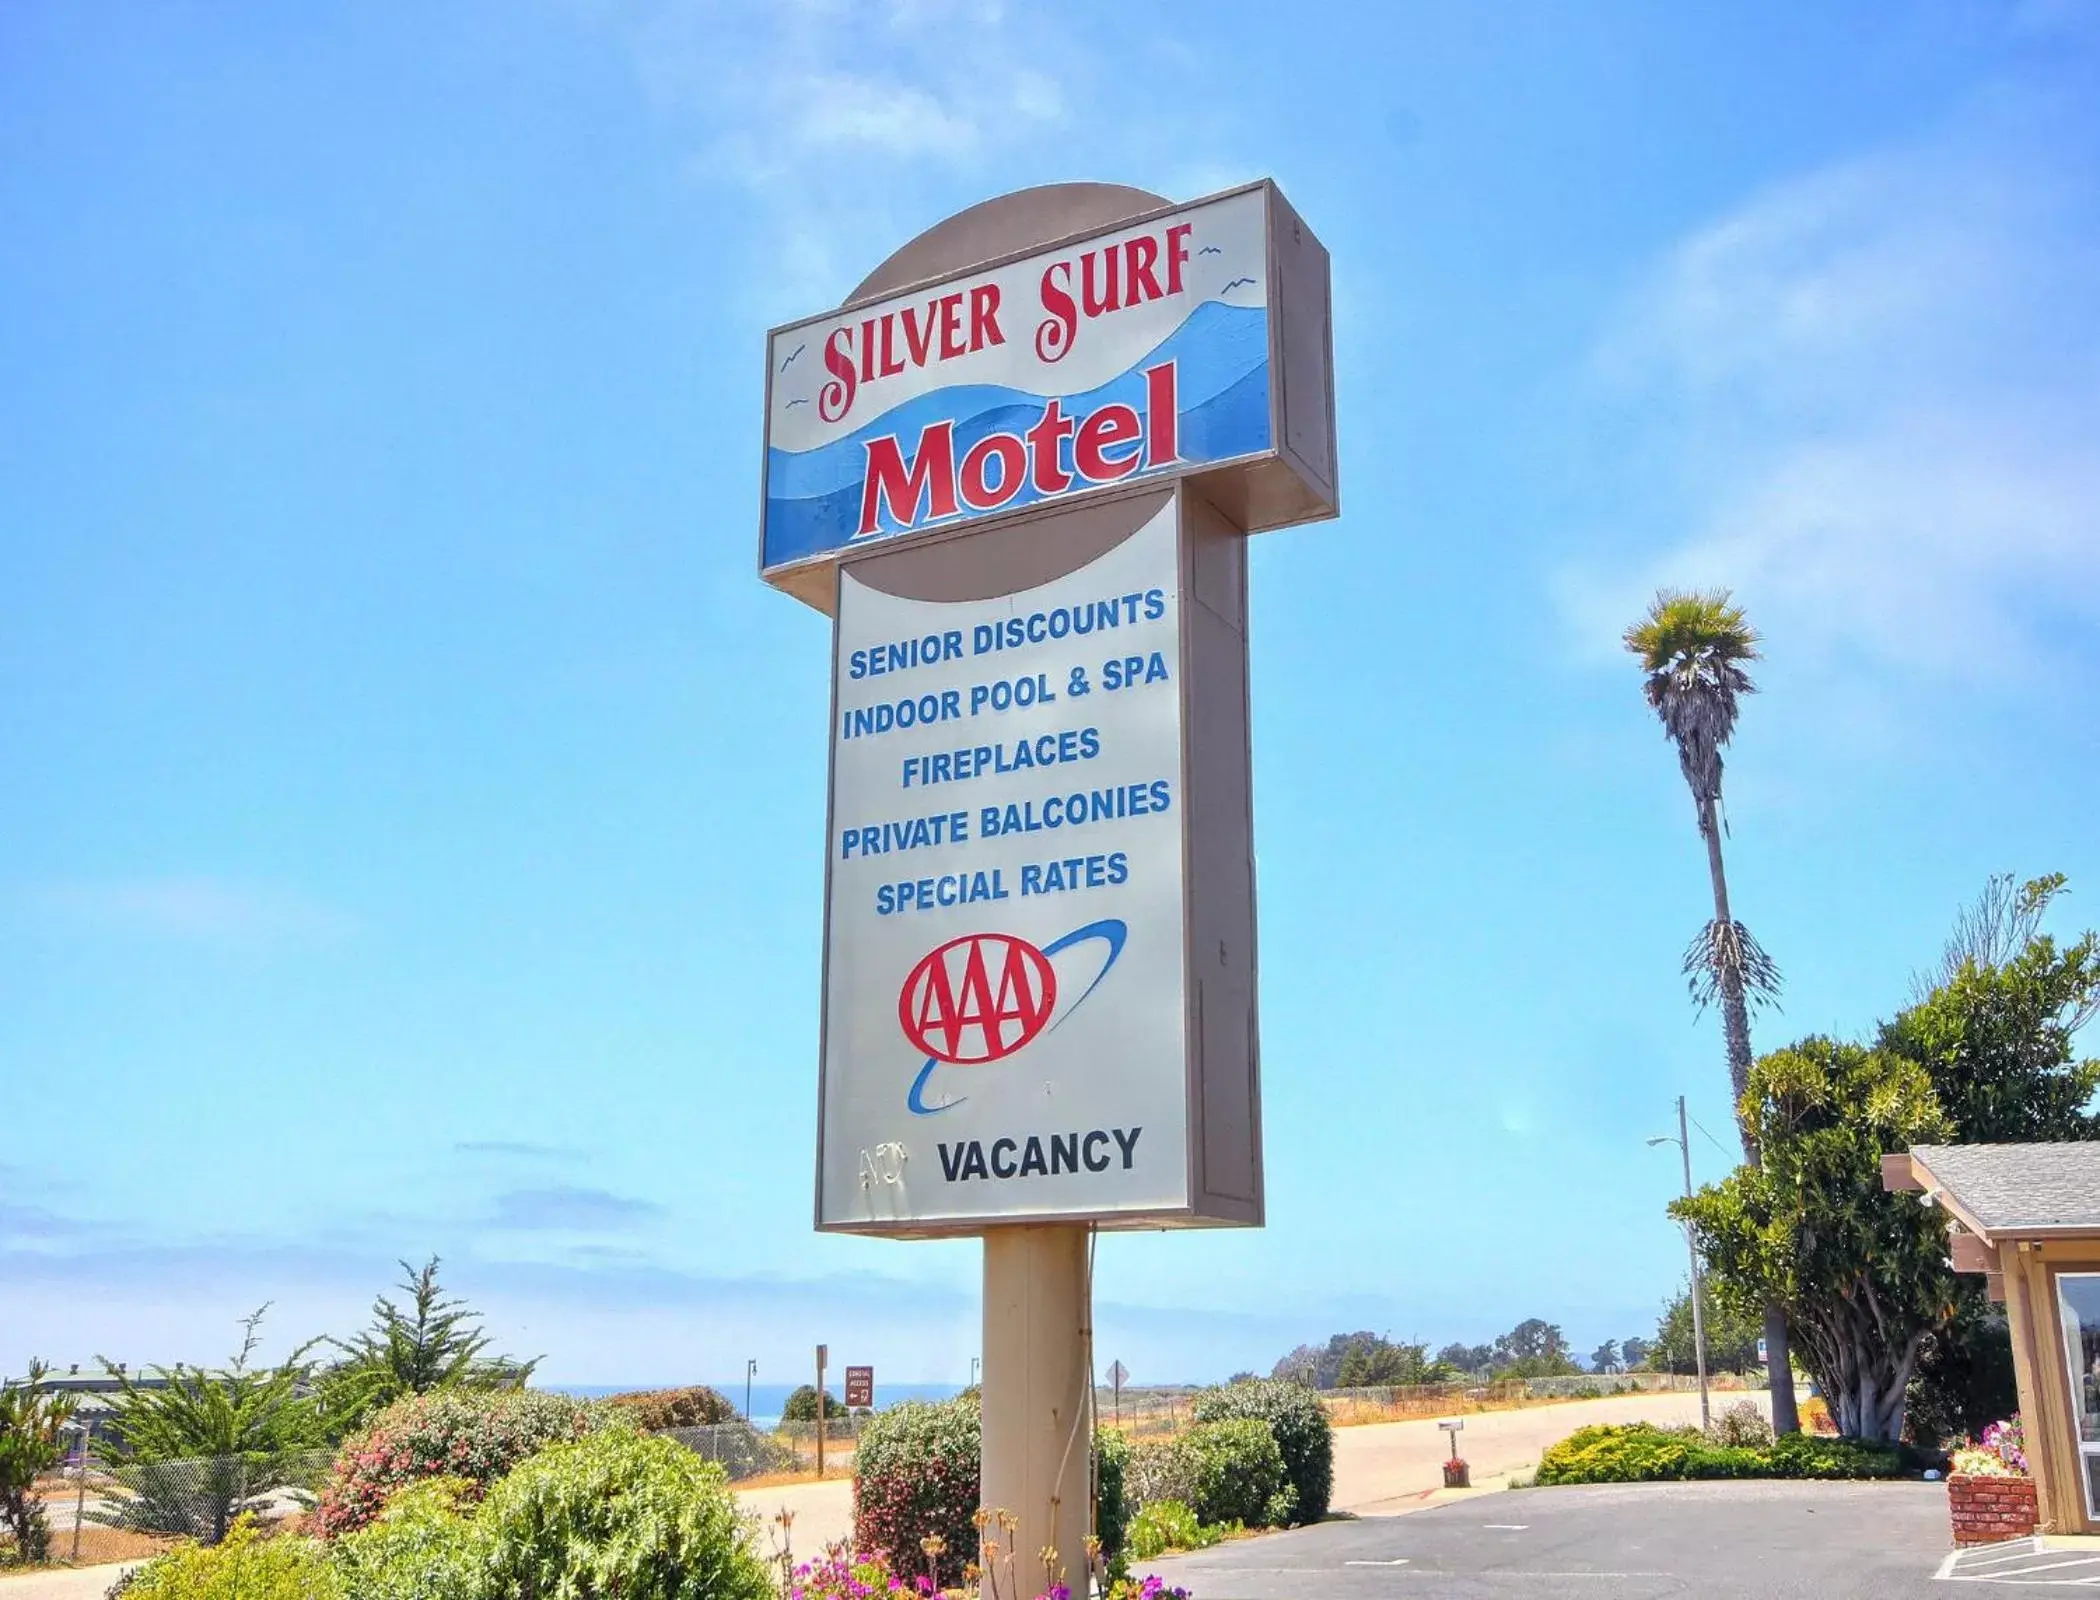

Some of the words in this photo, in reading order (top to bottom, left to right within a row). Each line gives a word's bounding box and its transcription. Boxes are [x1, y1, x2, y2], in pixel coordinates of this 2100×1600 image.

[818, 282, 1006, 424] SILVER
[1034, 222, 1193, 364] SURF
[854, 358, 1180, 537] Motel
[848, 630, 964, 680] SENIOR
[973, 588, 1166, 656] DISCOUNTS
[843, 690, 962, 740] INDOOR
[970, 673, 1056, 717] POOL
[1067, 666, 1091, 698] &
[1102, 651, 1169, 692] SPA
[902, 727, 1101, 789] FIREPLACES
[842, 811, 969, 860] PRIVATE
[980, 779, 1171, 839] BALCONIES
[875, 868, 1009, 916] SPECIAL
[1021, 852, 1129, 897] RATES
[912, 937, 1044, 1060] AAA
[937, 1126, 1142, 1183] VACANCY
